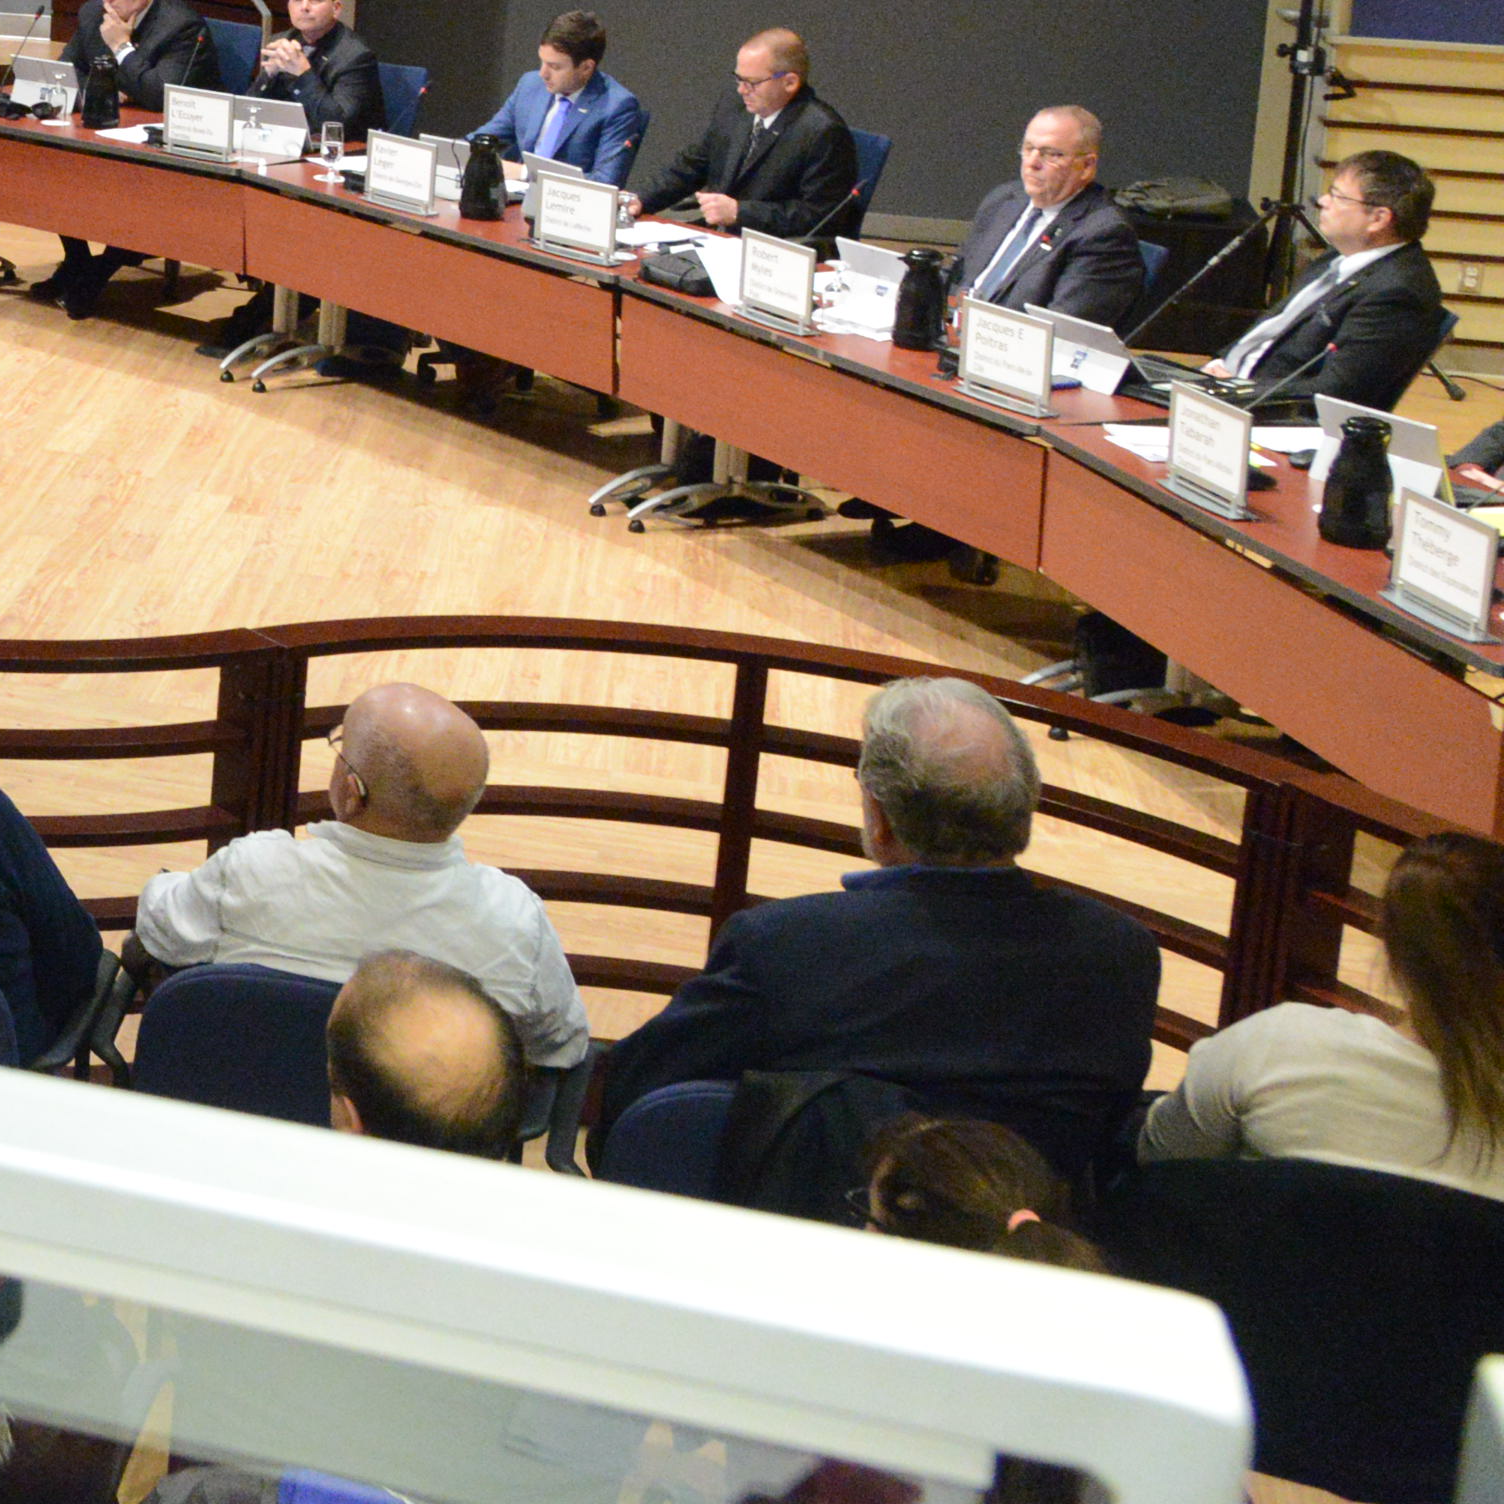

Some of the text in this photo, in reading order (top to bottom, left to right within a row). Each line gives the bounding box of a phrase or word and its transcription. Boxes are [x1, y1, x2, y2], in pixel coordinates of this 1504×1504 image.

[546, 185, 582, 203] Jacques
[544, 200, 577, 215] Lemire
[751, 245, 779, 264] Robert
[975, 315, 1016, 338] Jacques
[974, 331, 1009, 353] Poitras
[1413, 509, 1452, 543] Tommy
